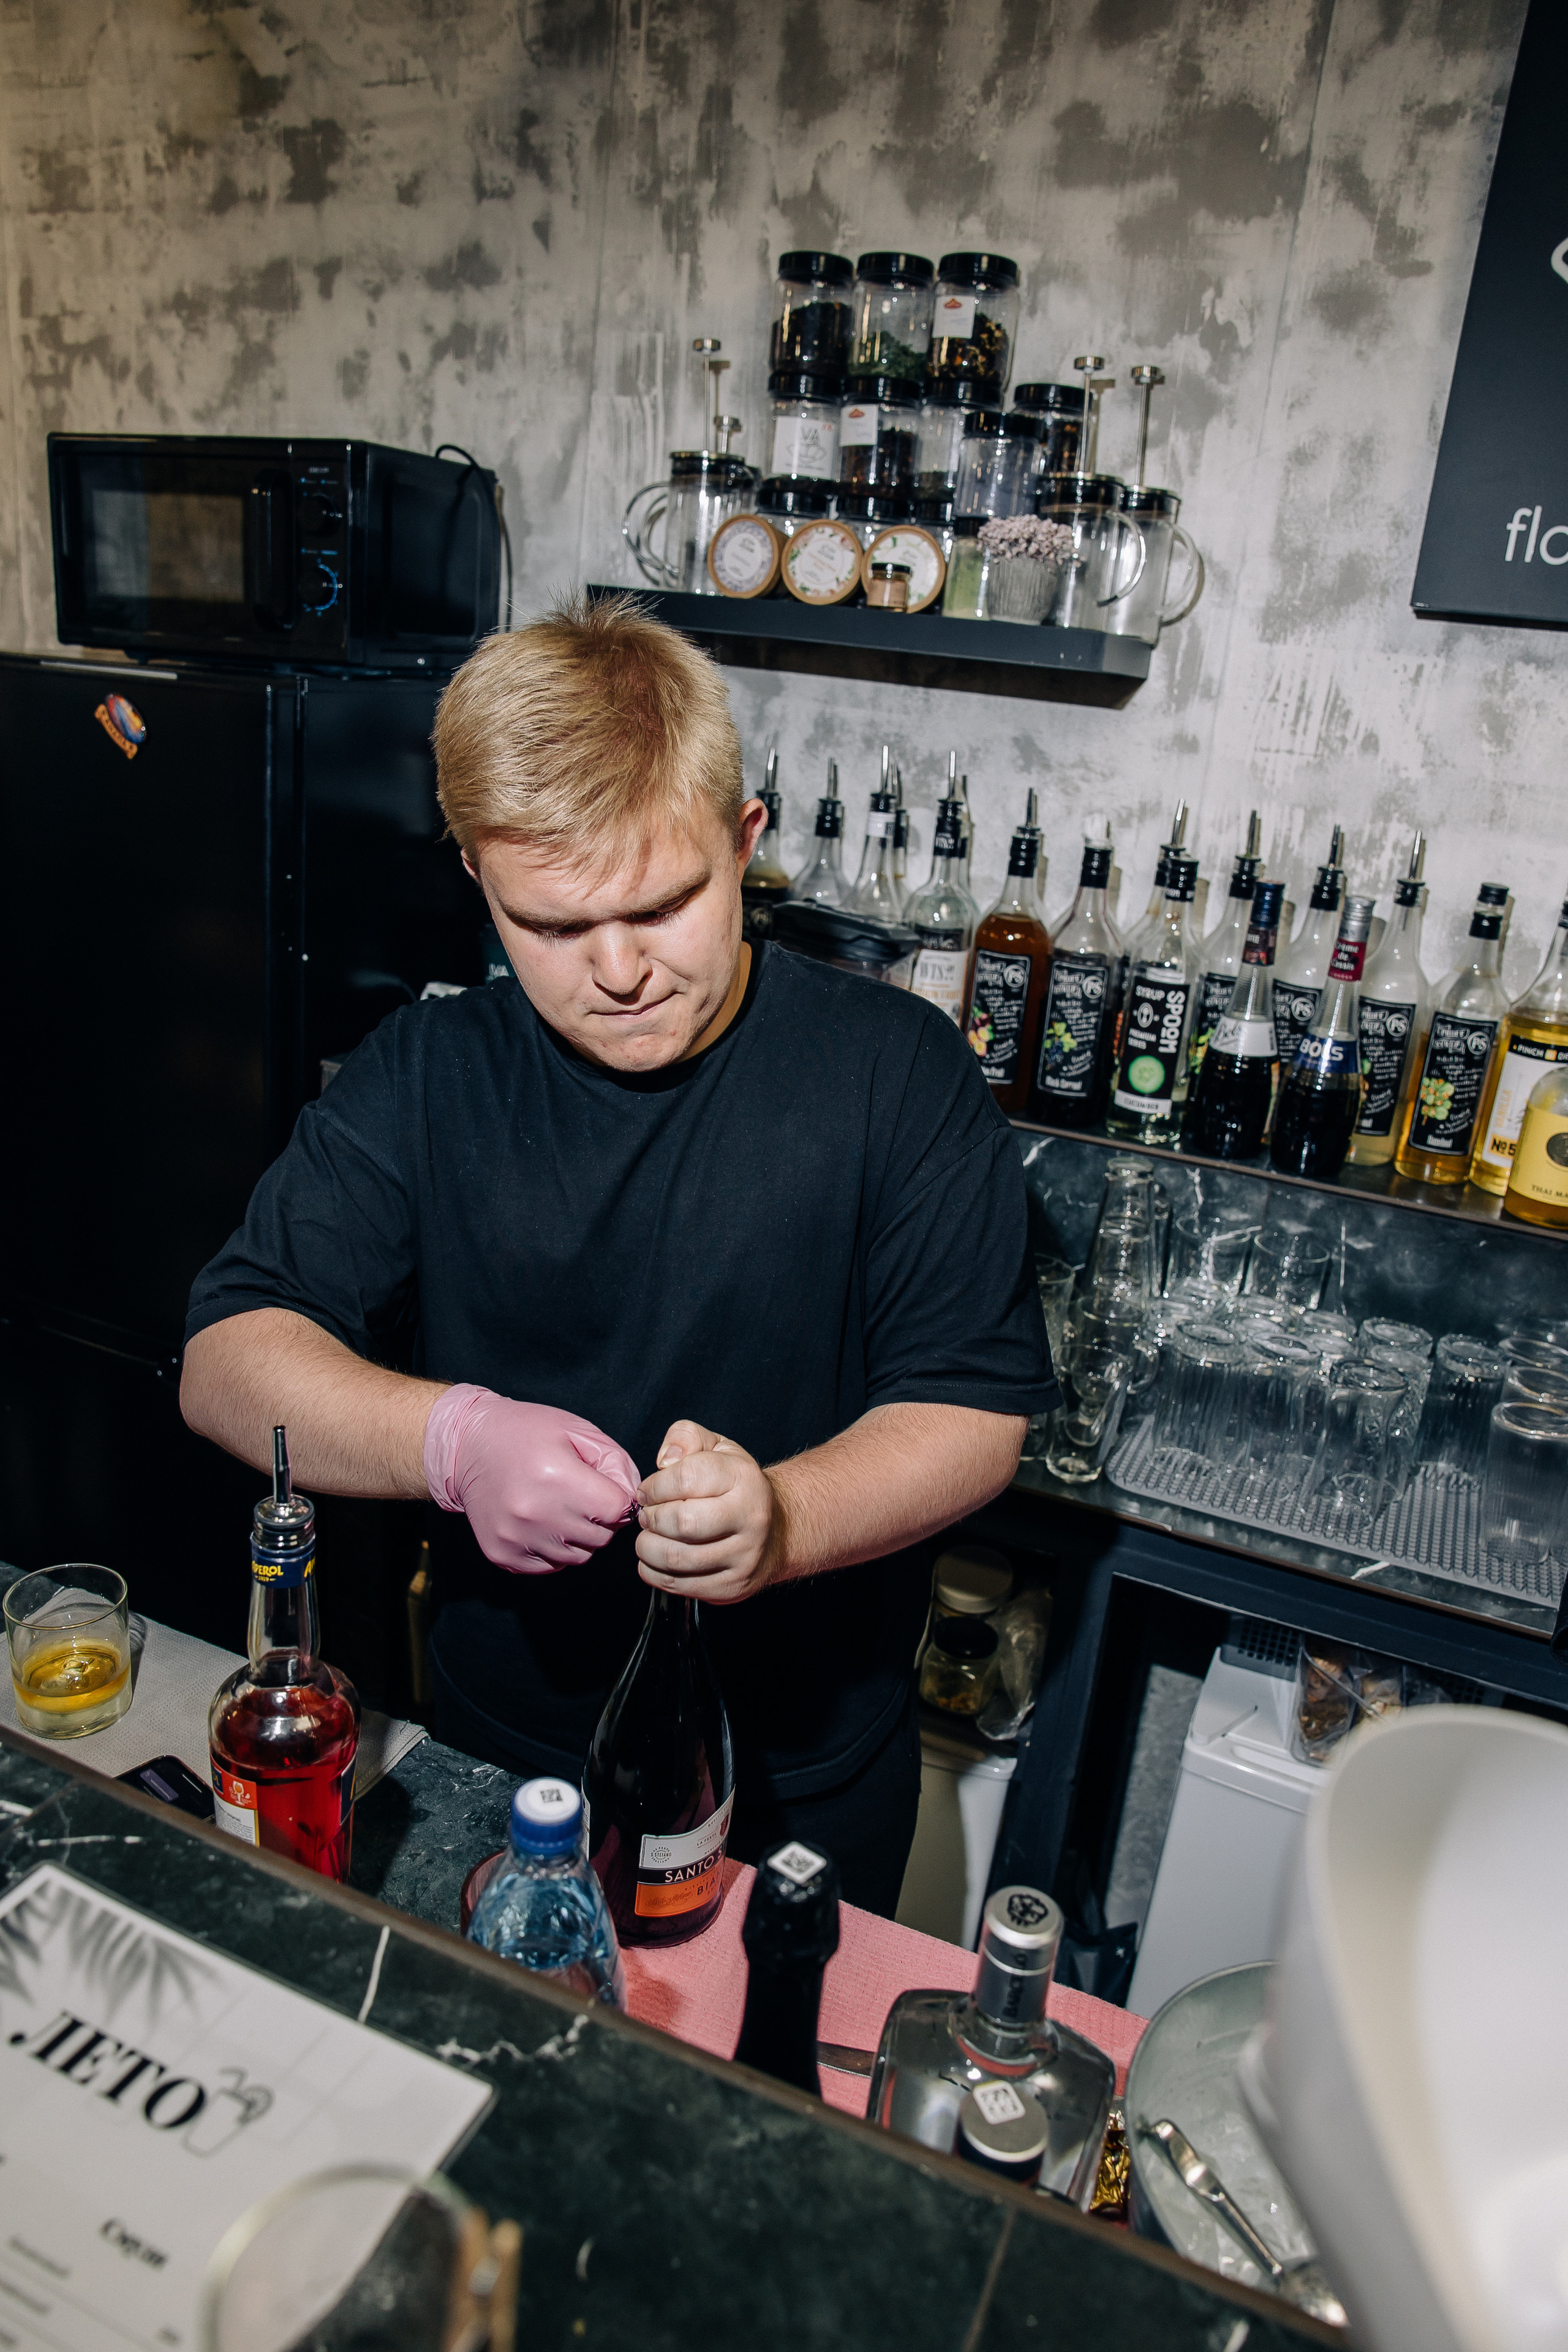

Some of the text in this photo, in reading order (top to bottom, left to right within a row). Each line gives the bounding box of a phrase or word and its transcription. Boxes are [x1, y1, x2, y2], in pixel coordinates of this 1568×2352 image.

[1136, 985, 1165, 1001] SYRUP
[1158, 990, 1186, 1054] SPOOM
[1128, 1036, 1147, 1050] SERIES
[1129, 1027, 1156, 1042] PREMIUM
[1299, 1038, 1344, 1061] BOLS
[1517, 1044, 1544, 1057] PINCH
[665, 1855, 715, 1883] SANTO
[9, 2010, 208, 2131] ЛЕТО
